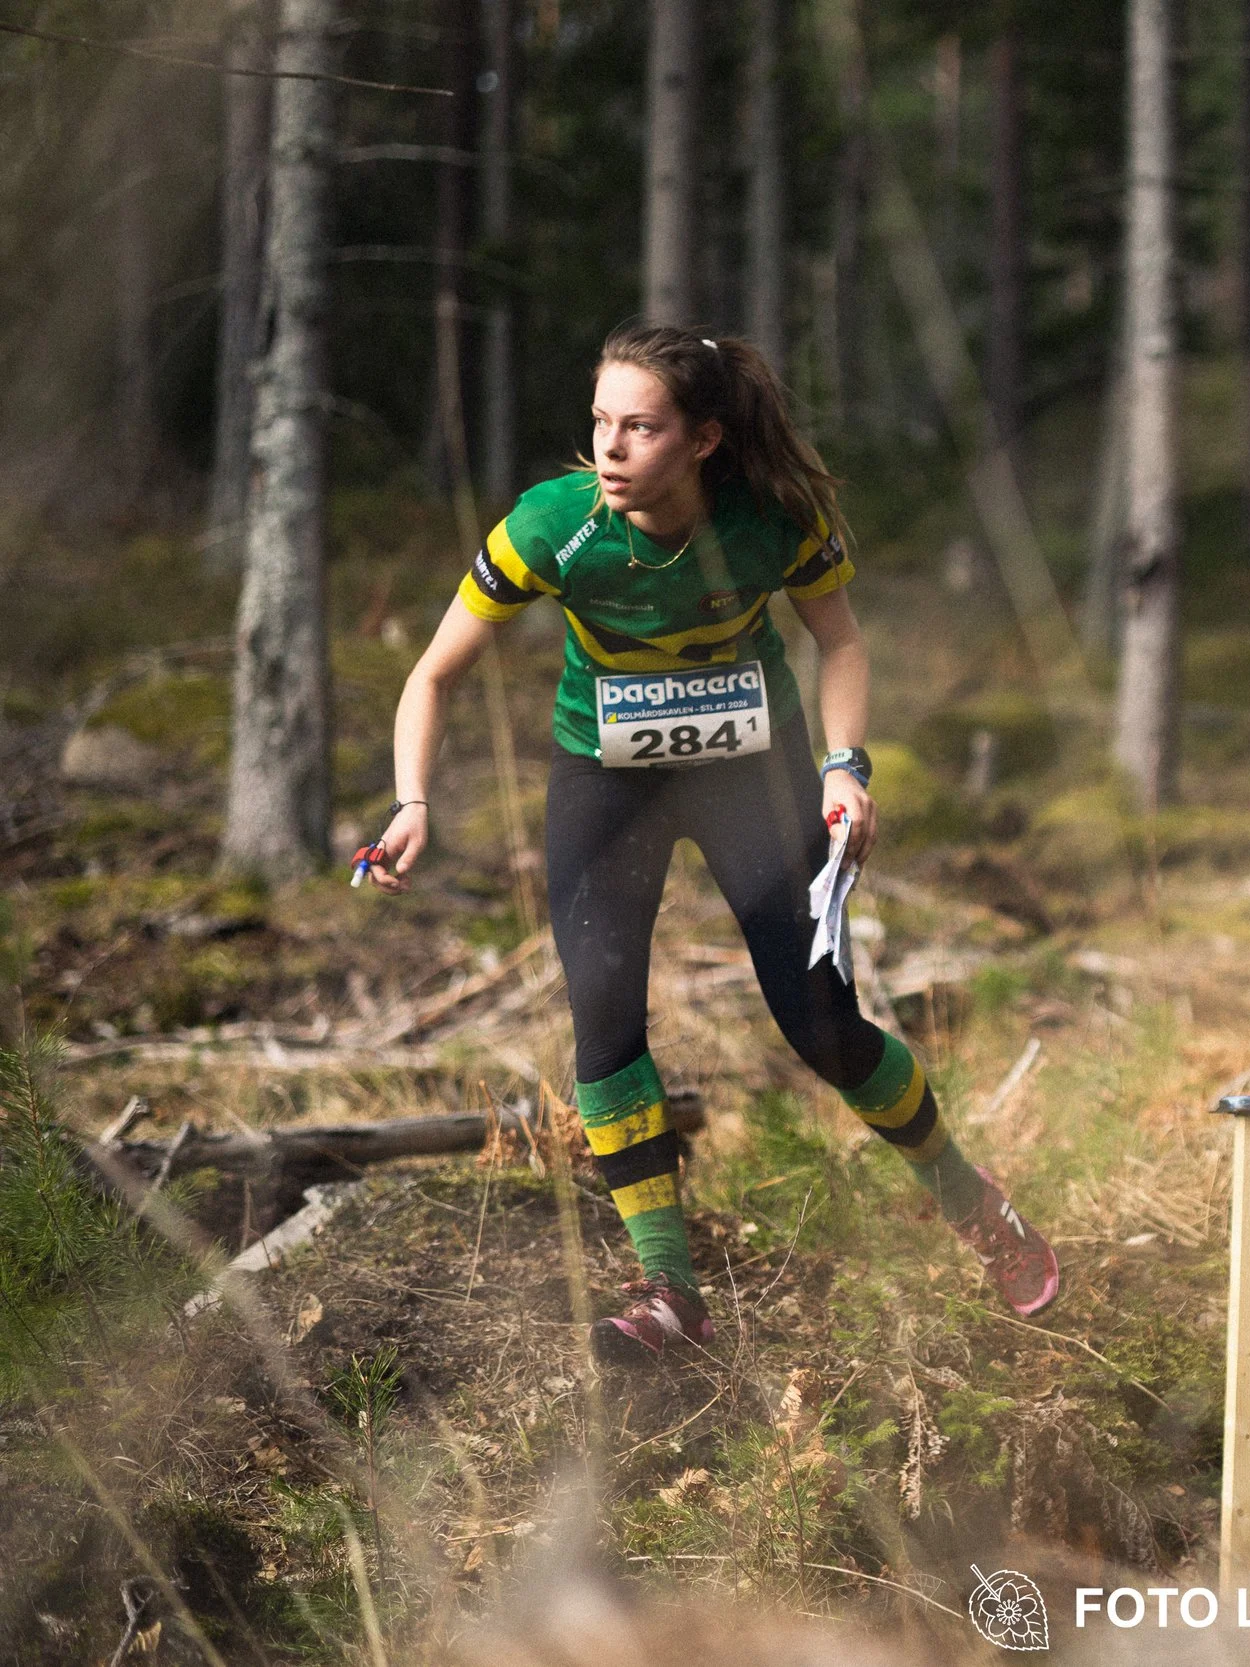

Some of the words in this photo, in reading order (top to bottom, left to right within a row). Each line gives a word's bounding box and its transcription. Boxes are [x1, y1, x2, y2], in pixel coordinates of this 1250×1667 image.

[555, 518, 599, 566] TRIMTEX
[602, 670, 760, 706] bagheera
[618, 706, 694, 720] KOLMÅRDSKAVLEN
[700, 704, 714, 712] STL
[728, 699, 748, 709] 2026
[747, 716, 757, 732] 1
[630, 720, 742, 761] 284
